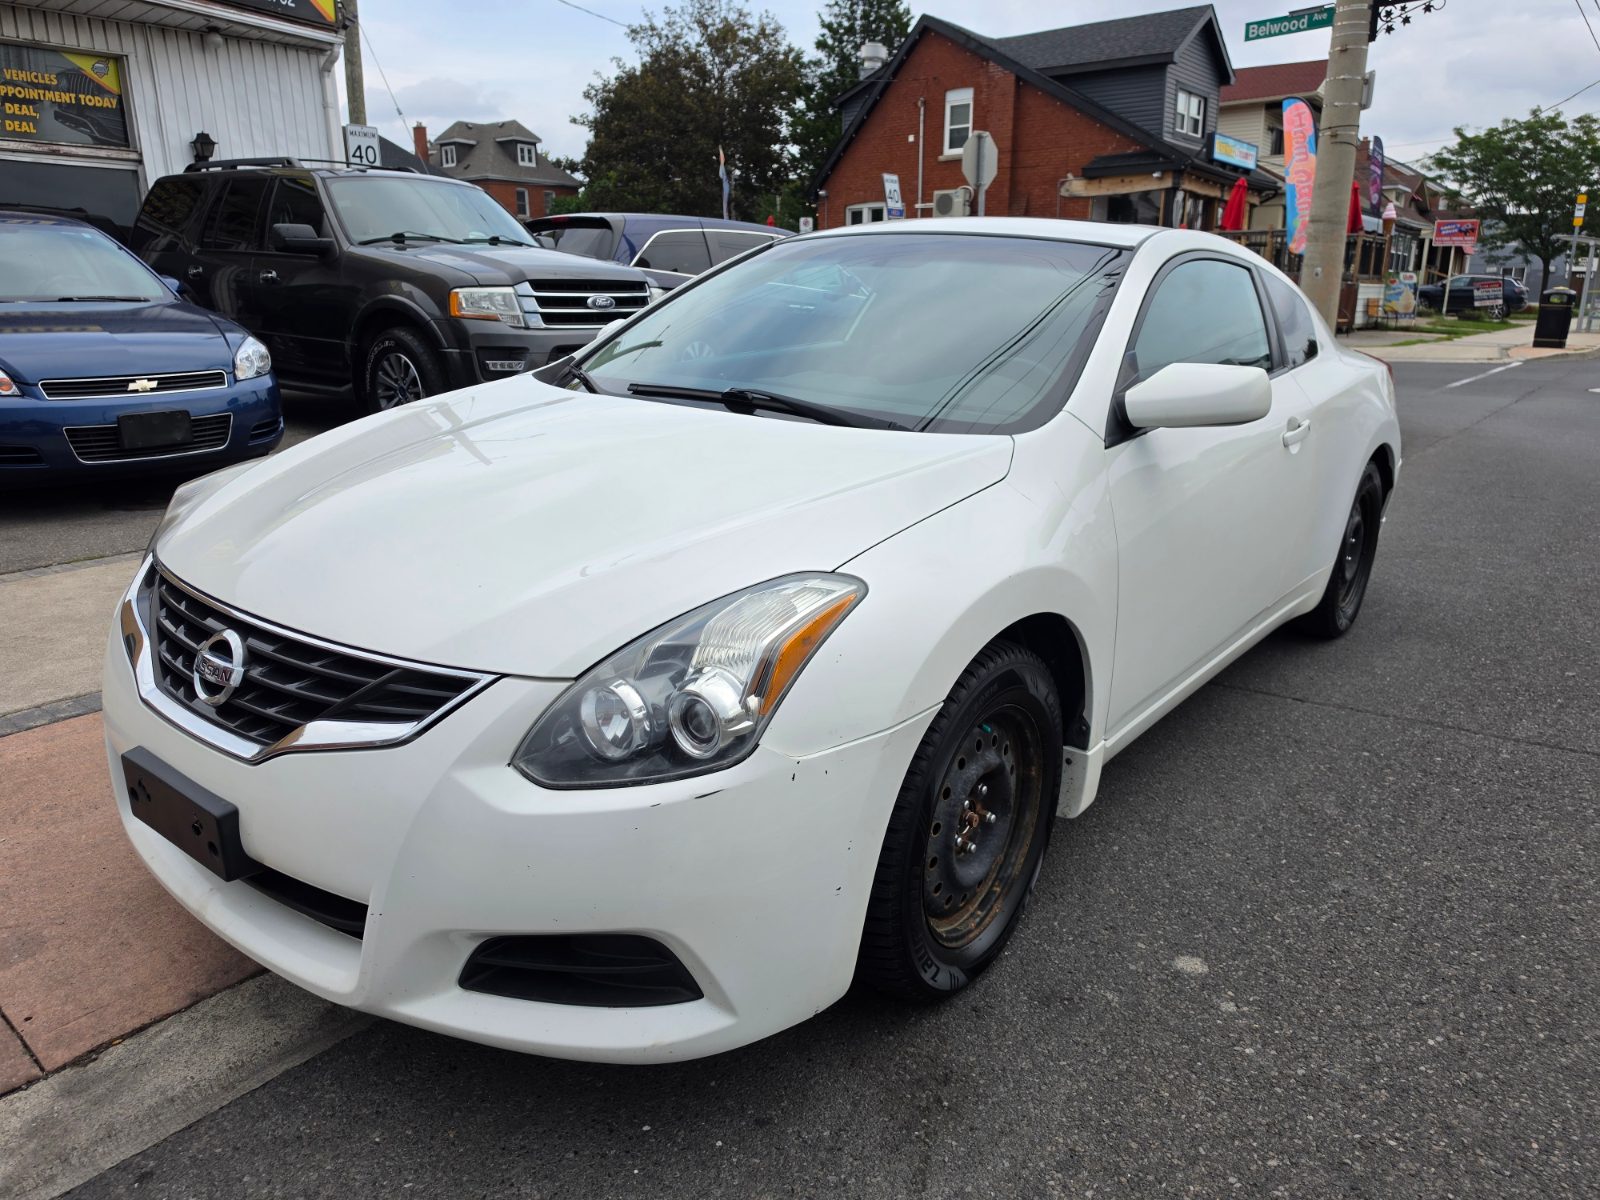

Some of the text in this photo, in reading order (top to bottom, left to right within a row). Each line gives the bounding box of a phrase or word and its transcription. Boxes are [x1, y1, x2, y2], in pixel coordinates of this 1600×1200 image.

[1248, 12, 1328, 38] Belwood Ave
[3, 68, 58, 85] VEHICLES
[0, 84, 118, 109] PPOINTMENT TODAY
[4, 103, 40, 119] DEAL,
[4, 120, 37, 133] DEAL
[350, 130, 376, 138] MAXIMUM
[351, 144, 377, 164] 40
[887, 188, 900, 204] 40
